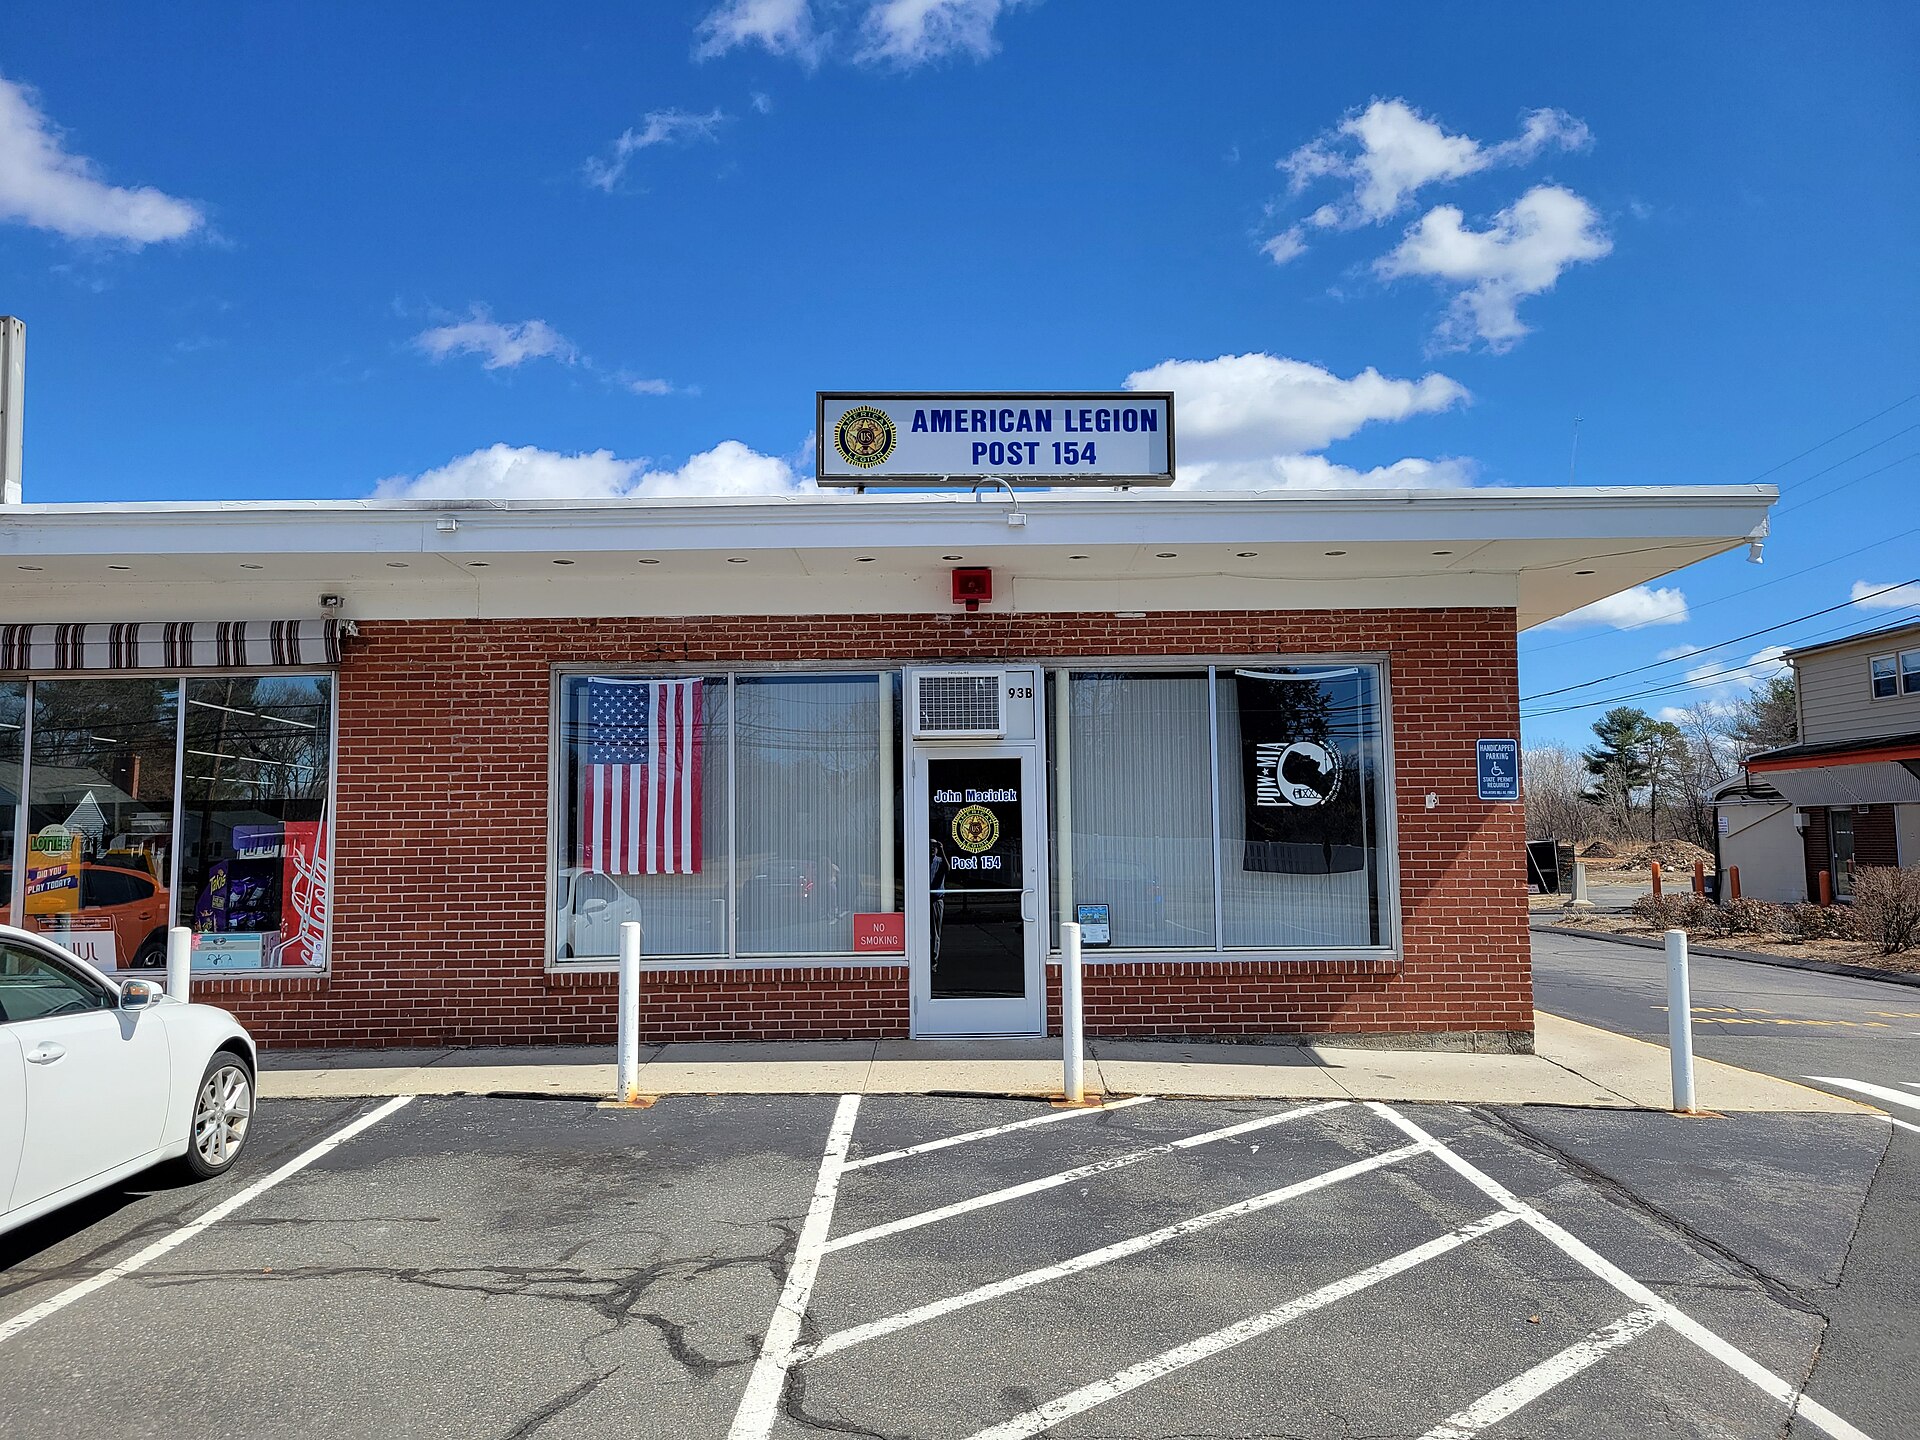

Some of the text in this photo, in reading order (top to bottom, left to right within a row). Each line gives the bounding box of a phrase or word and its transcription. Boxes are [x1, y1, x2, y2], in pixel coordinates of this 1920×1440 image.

[842, 411, 890, 430] AMERICAN
[911, 408, 1158, 433] AMERICAN LEGION
[860, 432, 872, 442] US
[971, 441, 1097, 465] POST 154
[1008, 687, 1033, 699] 93B
[934, 789, 1018, 803] John Maciolek
[951, 856, 1001, 869] Post 154
[37, 866, 62, 879] DID YOU
[27, 877, 71, 895] PLAY TODAY?
[209, 874, 227, 896] Takis
[873, 923, 885, 932] NO
[860, 936, 898, 945] SMOKING
